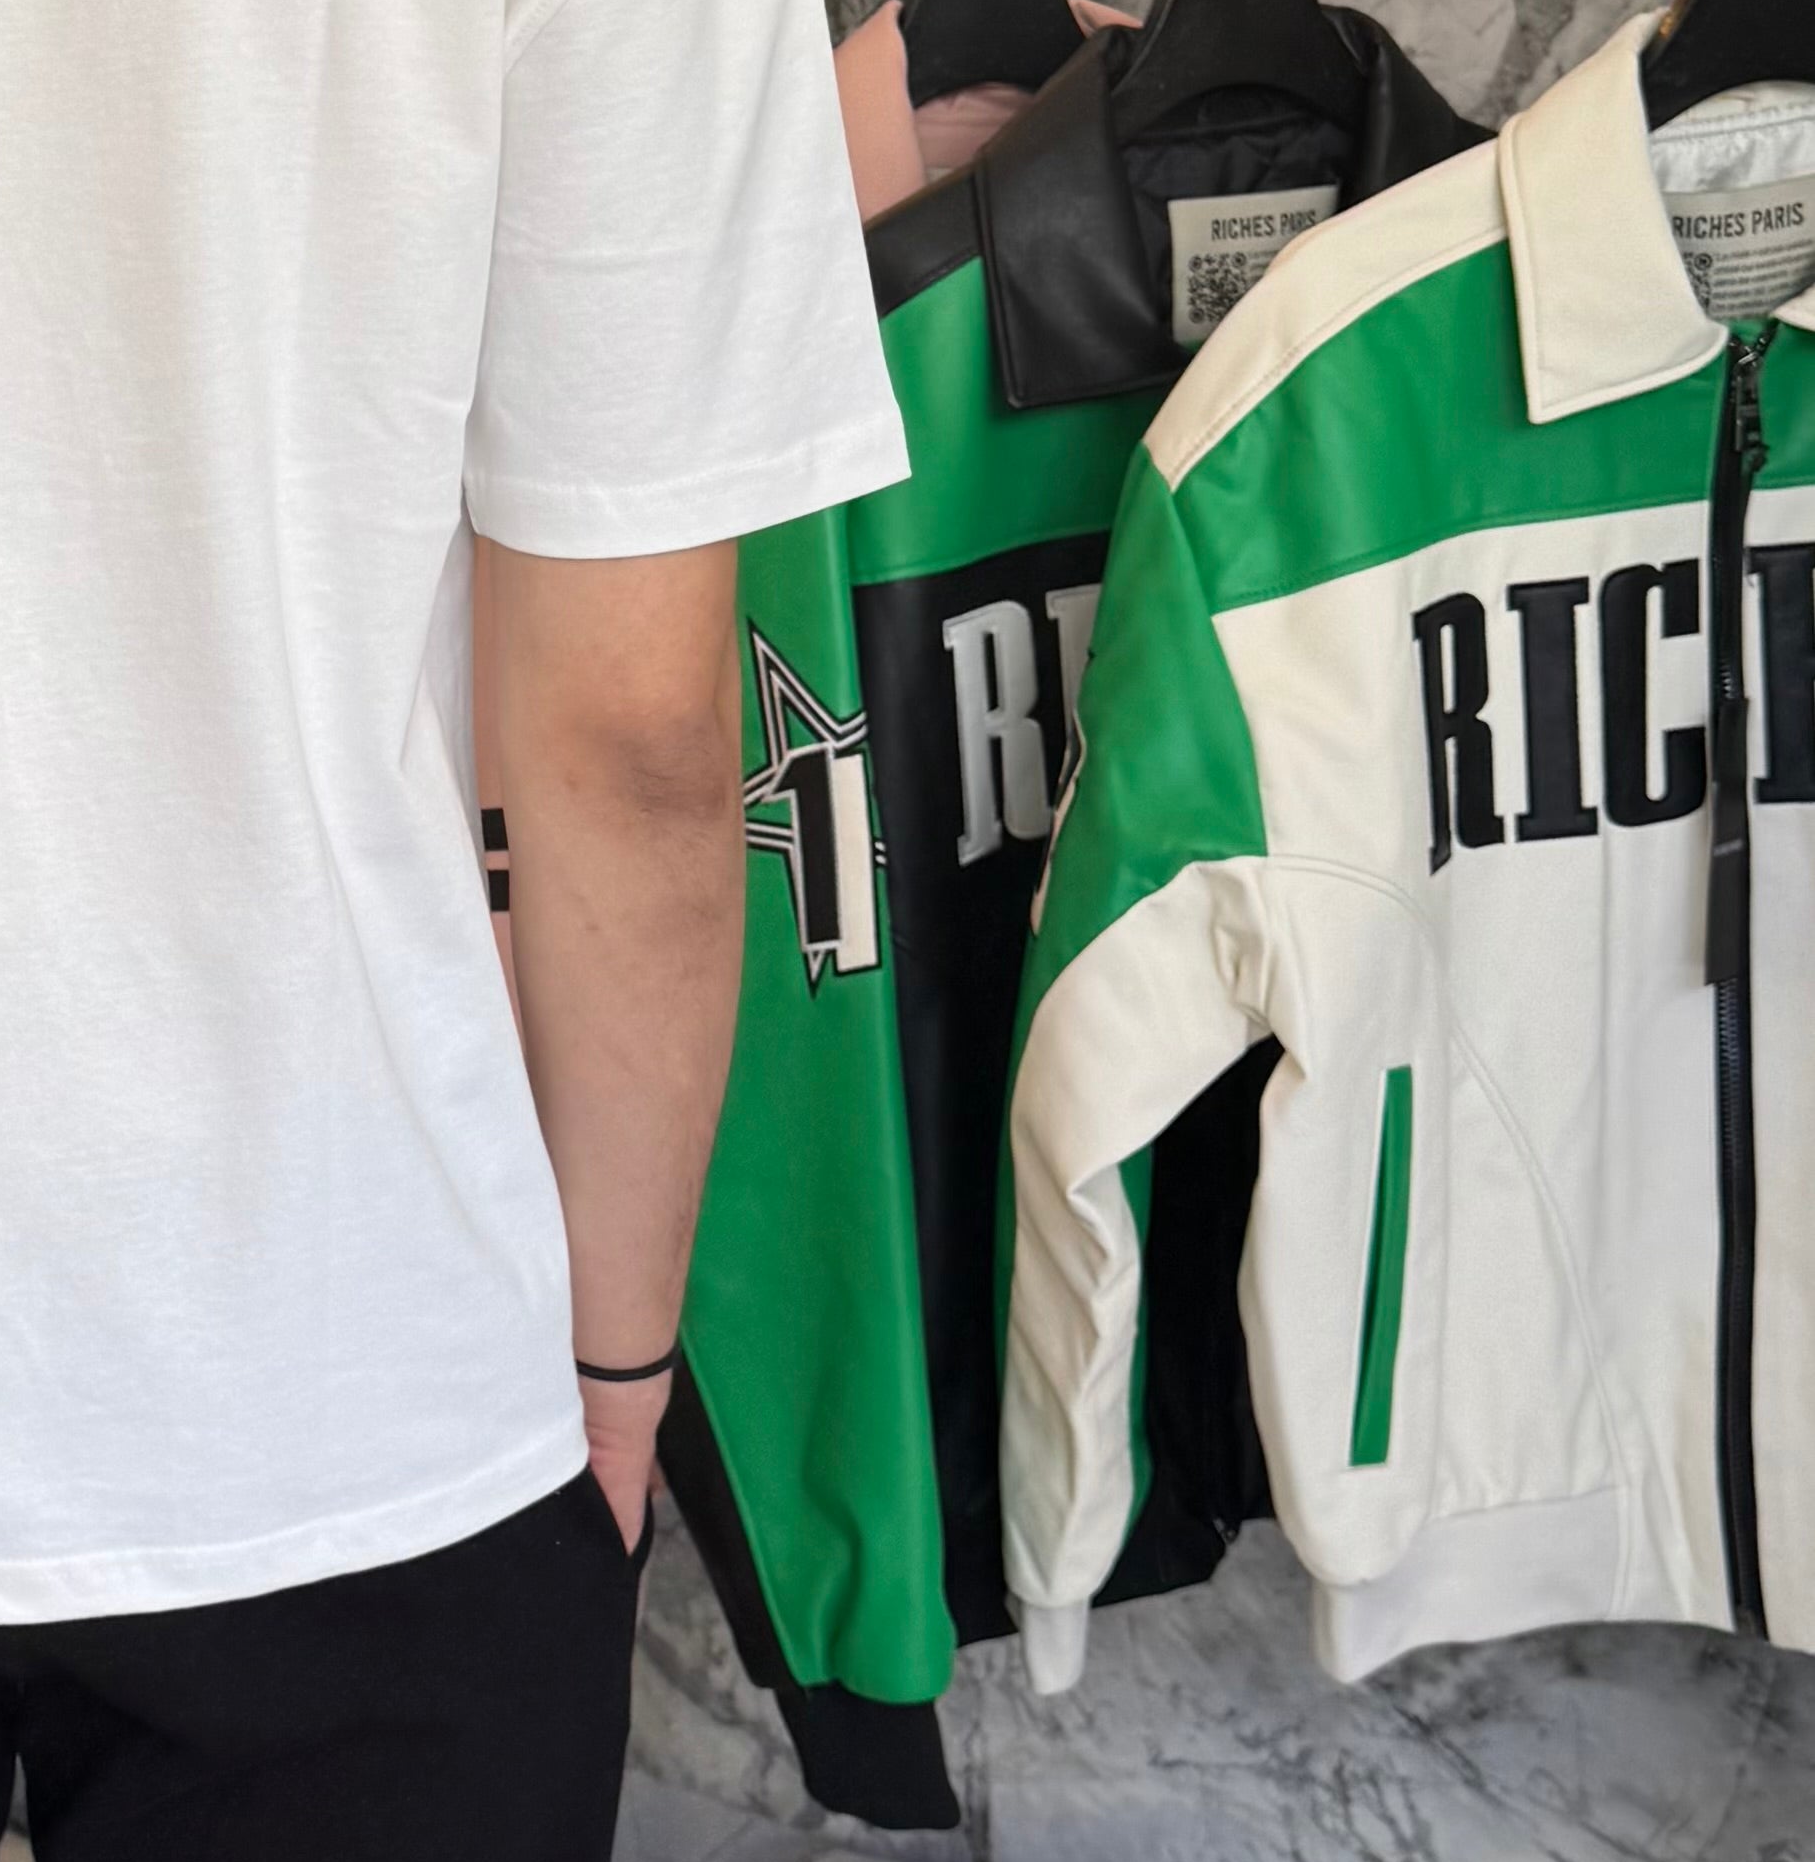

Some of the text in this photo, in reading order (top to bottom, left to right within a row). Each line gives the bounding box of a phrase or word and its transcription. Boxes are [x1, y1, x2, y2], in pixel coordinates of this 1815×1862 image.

[1211, 214, 1275, 240] RICHES
[1672, 202, 1804, 239] RICHES PARIS
